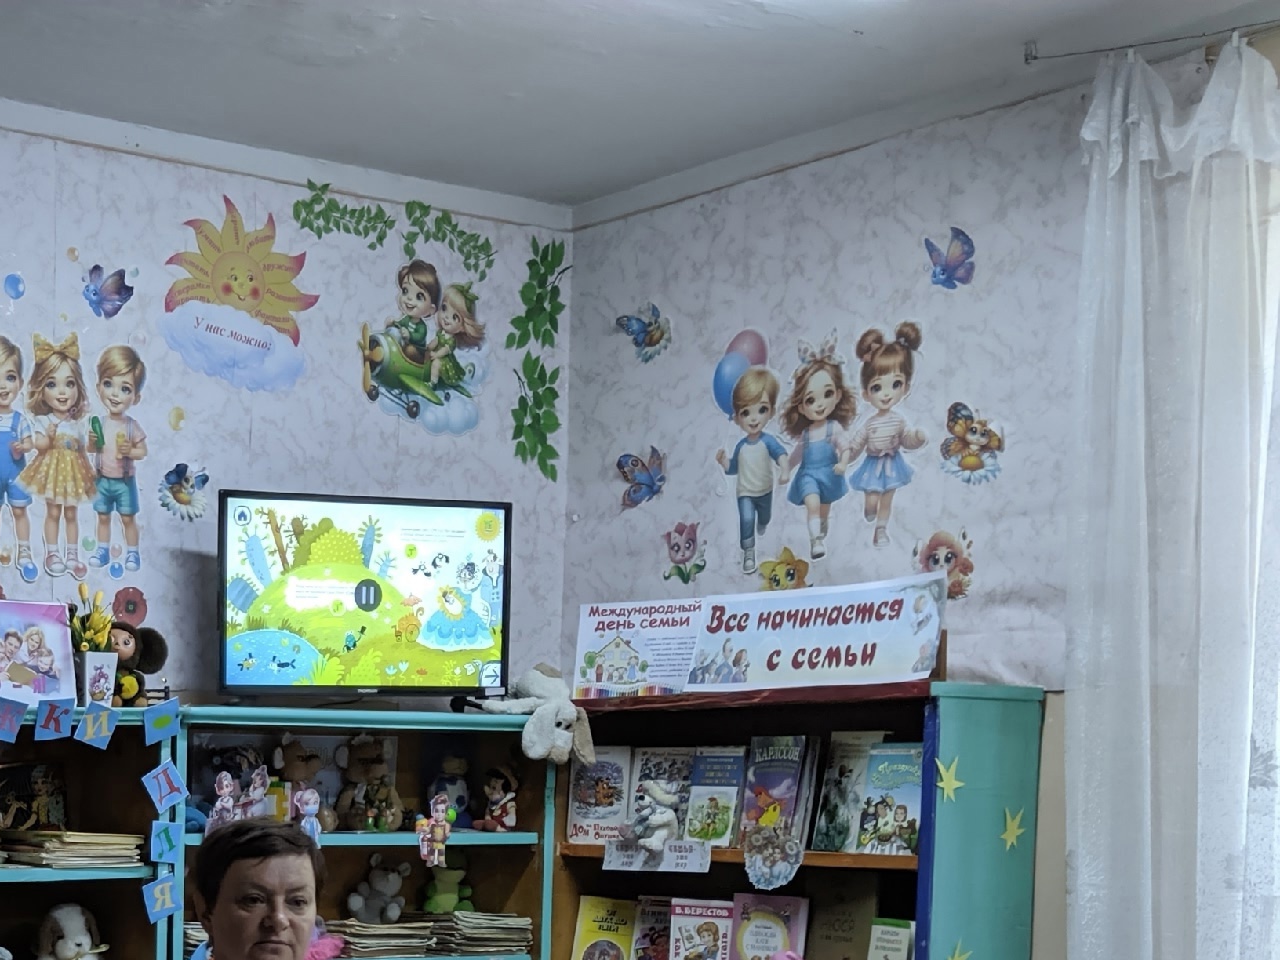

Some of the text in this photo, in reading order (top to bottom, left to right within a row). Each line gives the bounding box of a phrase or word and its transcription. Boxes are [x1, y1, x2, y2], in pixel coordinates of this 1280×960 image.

[194, 317, 204, 329] У
[205, 323, 226, 337] нас
[588, 600, 702, 618] Международный
[706, 598, 904, 634] Все начинается
[595, 616, 690, 632] день семьи
[767, 643, 878, 671] с семьи
[755, 747, 801, 762] КАРЛССОН
[685, 906, 729, 916] БЕРЕСТОВ
